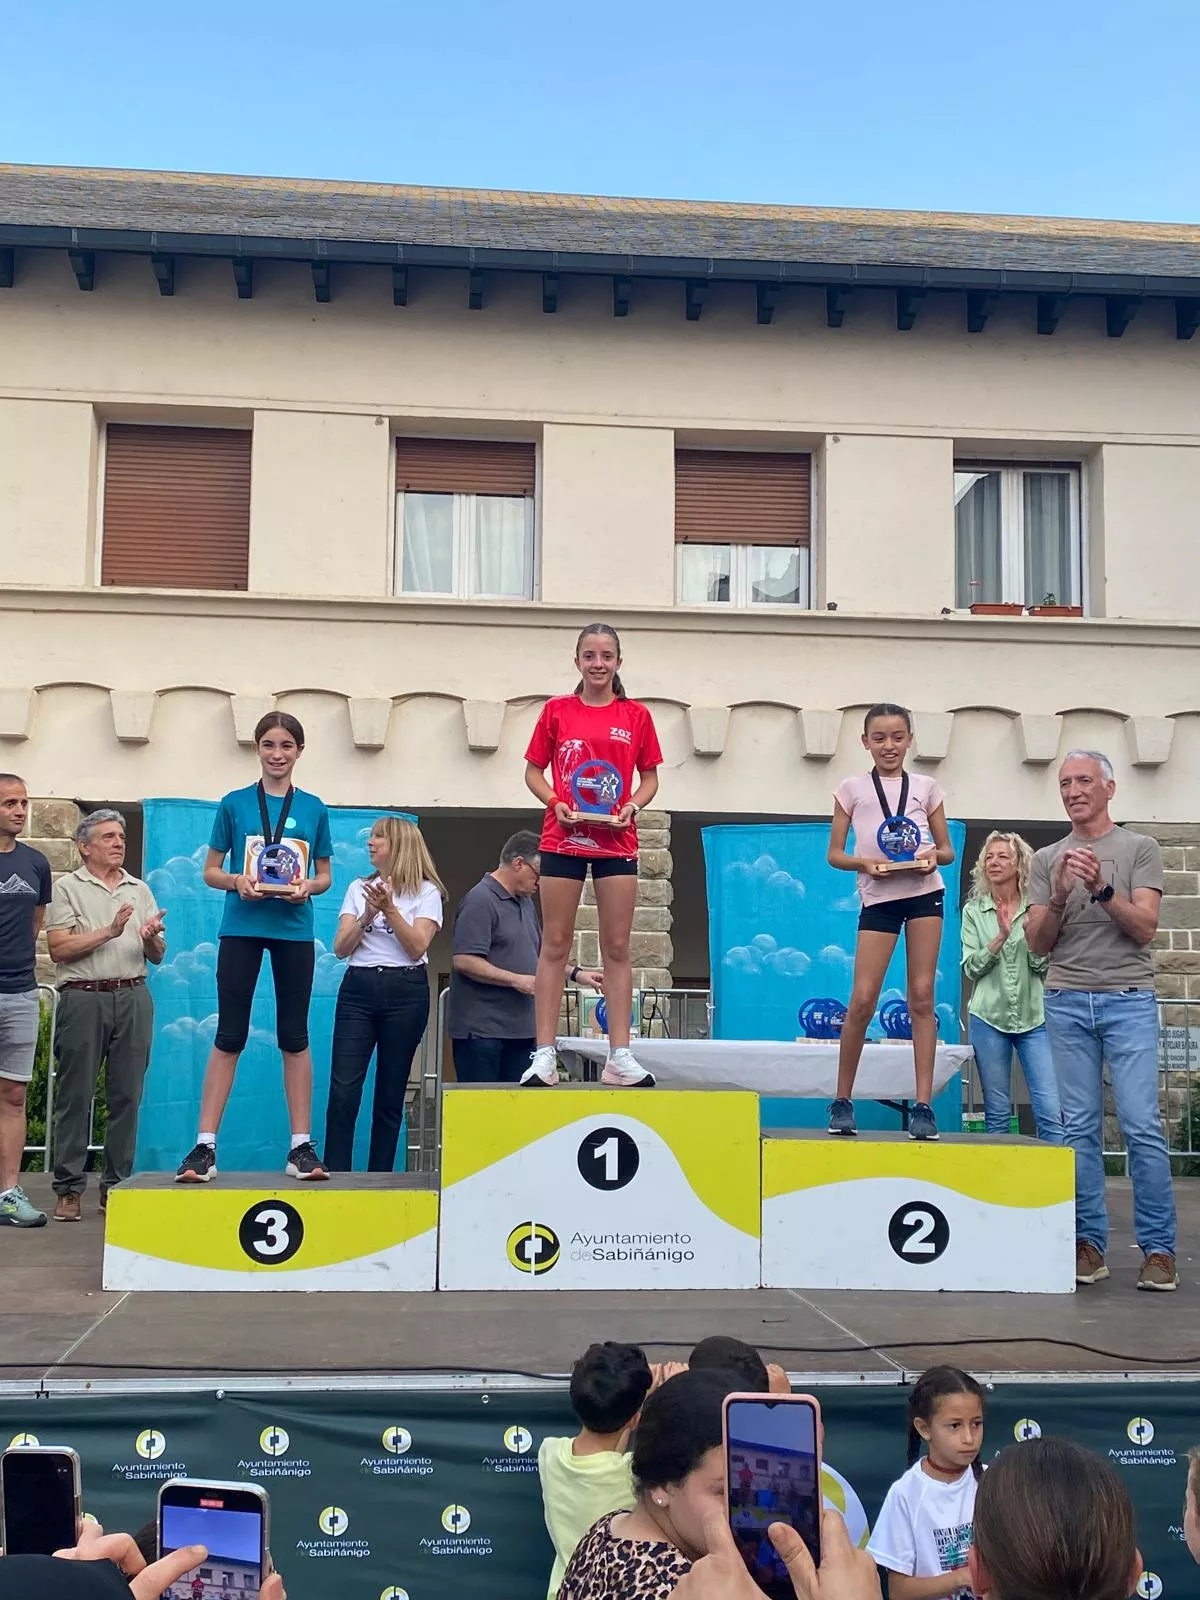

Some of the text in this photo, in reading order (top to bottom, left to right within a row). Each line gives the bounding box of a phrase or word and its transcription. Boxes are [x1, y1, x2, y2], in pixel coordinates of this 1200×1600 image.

[610, 726, 631, 740] ZGZ
[593, 1137, 619, 1180] 1
[252, 1208, 290, 1255] 3
[901, 1210, 935, 1253] 2
[571, 1232, 691, 1247] Ayuntamiento
[1108, 1448, 1174, 1457] Ayuntamiento
[237, 1459, 310, 1468] Ayuntamiento
[360, 1457, 432, 1467] Ayuntamiento
[482, 1457, 538, 1466] Ayuntamie
[112, 1462, 186, 1472] Ayuntamiento
[494, 1464, 538, 1473] Sabiñán
[296, 1540, 369, 1549] Ayuntamiento
[419, 1538, 491, 1547] Ayuntamiento
